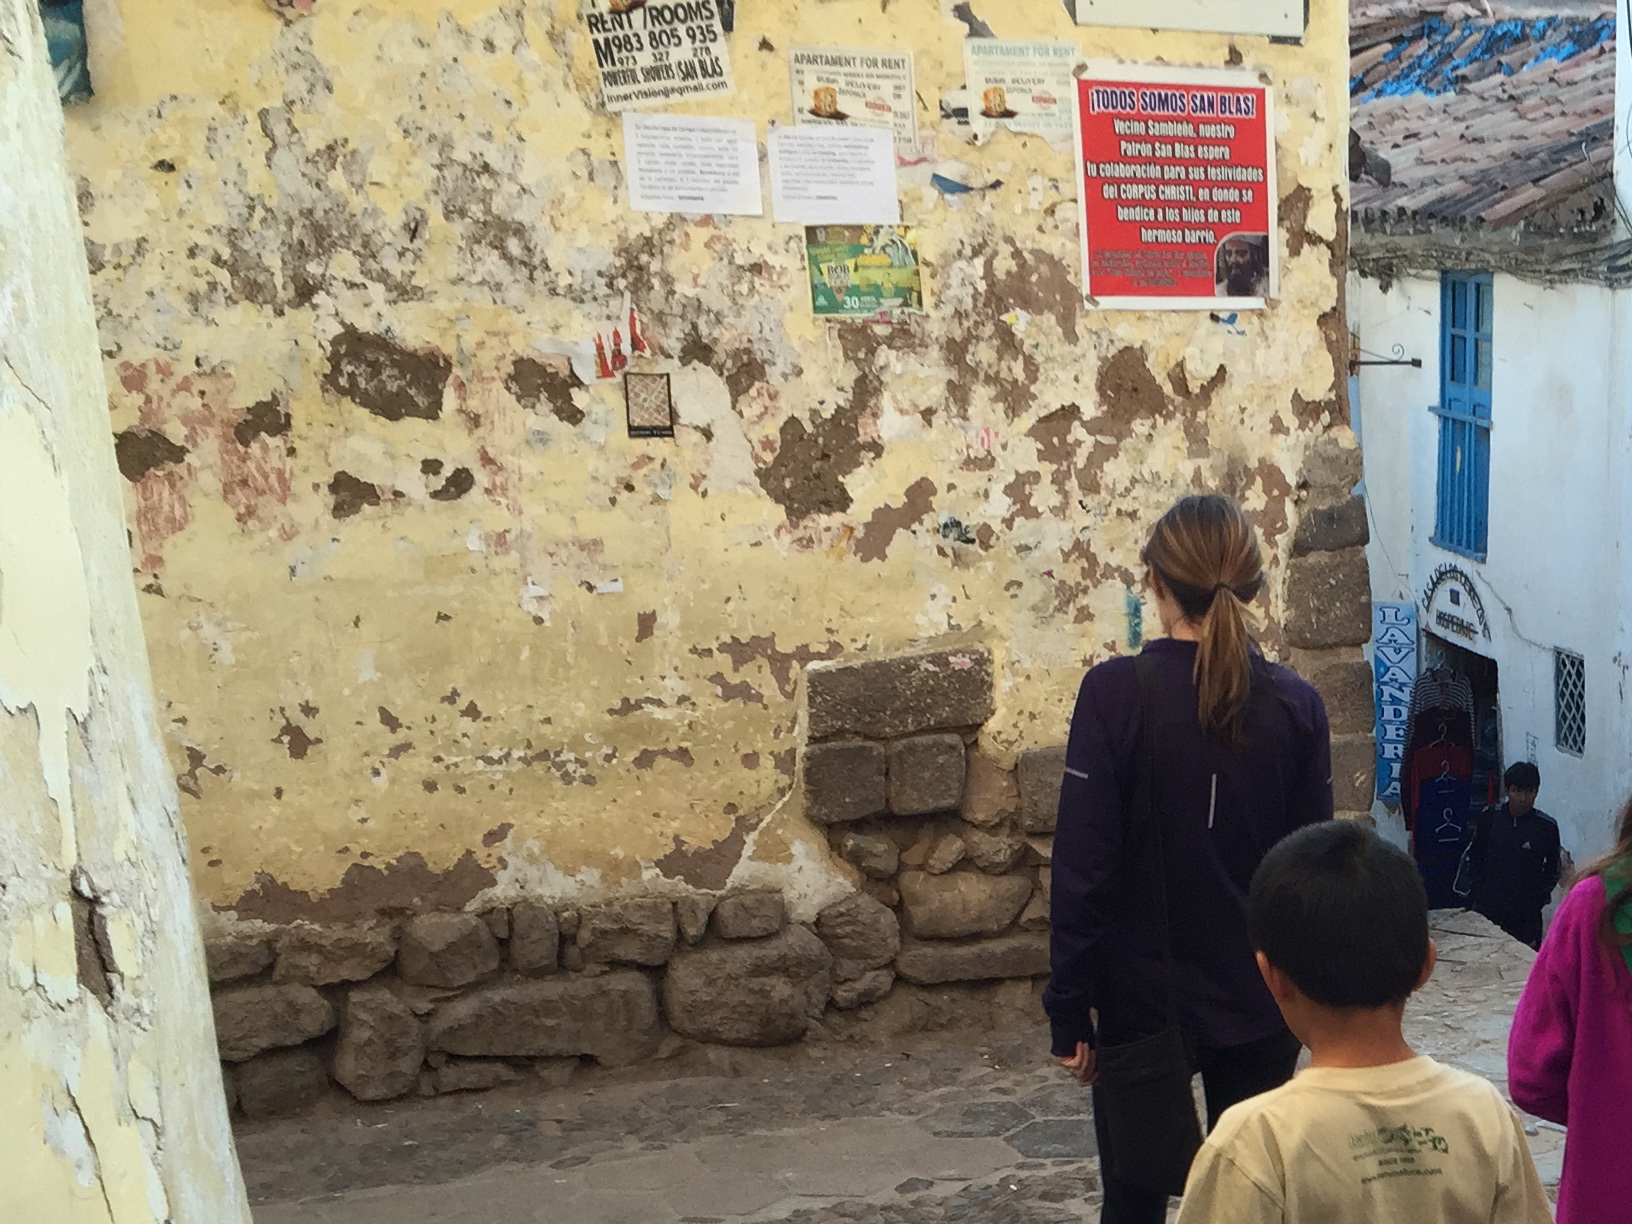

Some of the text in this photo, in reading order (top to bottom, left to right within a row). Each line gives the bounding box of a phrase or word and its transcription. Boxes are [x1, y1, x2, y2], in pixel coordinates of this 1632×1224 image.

[586, 10, 635, 35] RENT
[648, 27, 683, 51] 805
[686, 24, 719, 47] 935
[617, 55, 638, 68] 973
[651, 50, 671, 64] 327
[794, 53, 906, 69] APARTAMENT FOR RENT
[971, 45, 1076, 57] APARTAMENT FOR RENT
[601, 67, 641, 89] POWERFUL
[641, 61, 675, 84] SHOWERS
[699, 56, 724, 79] BLAS
[1140, 90, 1187, 114] SOMOS
[1190, 93, 1216, 115] SAN
[1219, 95, 1256, 117] BLAS!
[1113, 118, 1146, 135] Vecino
[1199, 121, 1235, 138] nuestro
[1120, 140, 1231, 160] Patrón San Blas espera
[1087, 160, 1265, 182] tu colaboración para sus festividades
[1102, 183, 1119, 200] del
[1120, 182, 1157, 200] CORPUS
[1198, 188, 1211, 201] en
[1212, 186, 1240, 202] donde
[1241, 187, 1254, 203] se
[1117, 204, 1242, 225] bendice a los hijos de este
[1141, 226, 1218, 244] hermoso barrio.
[843, 296, 860, 309] 30
[1376, 606, 1416, 800] LAVANDERIA
